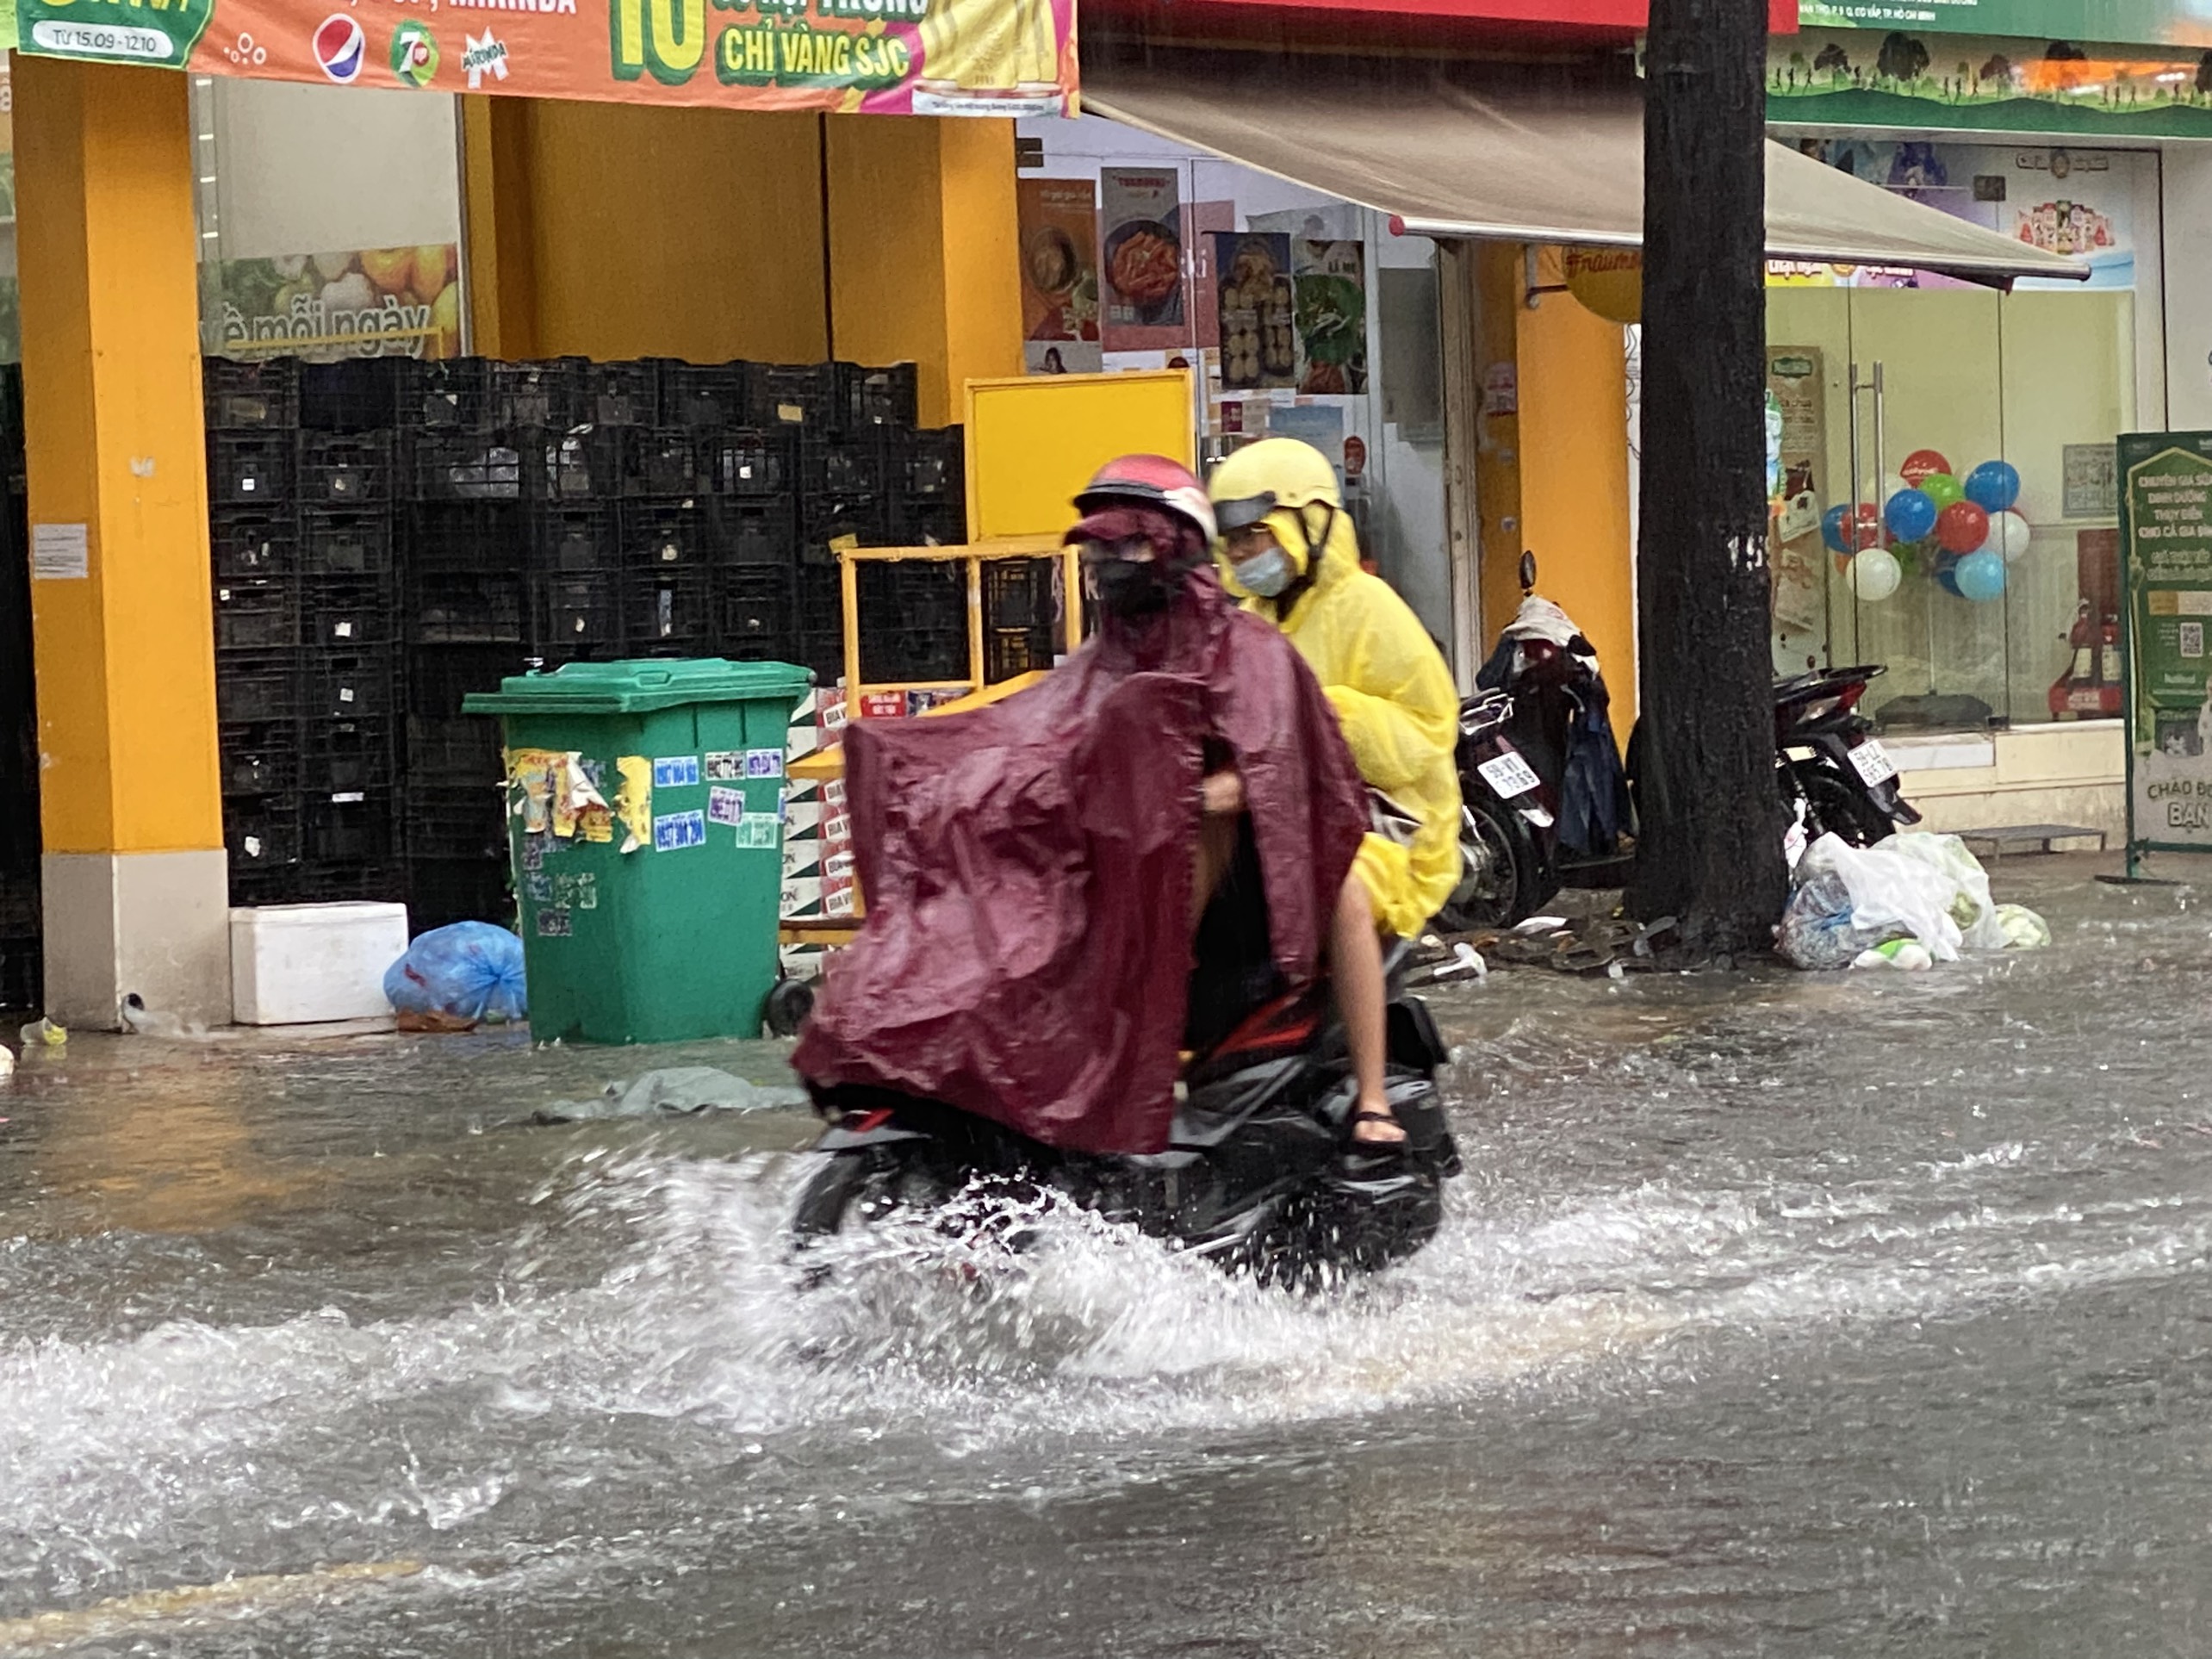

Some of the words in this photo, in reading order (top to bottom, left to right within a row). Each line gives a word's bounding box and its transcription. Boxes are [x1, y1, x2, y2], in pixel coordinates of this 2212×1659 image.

[724, 19, 774, 71] CHỈ
[781, 22, 852, 76] VÀNG
[854, 37, 910, 78] SJC
[255, 295, 325, 355] mỗi
[332, 295, 430, 359] ngày
[2167, 802, 2210, 834] BẠN
